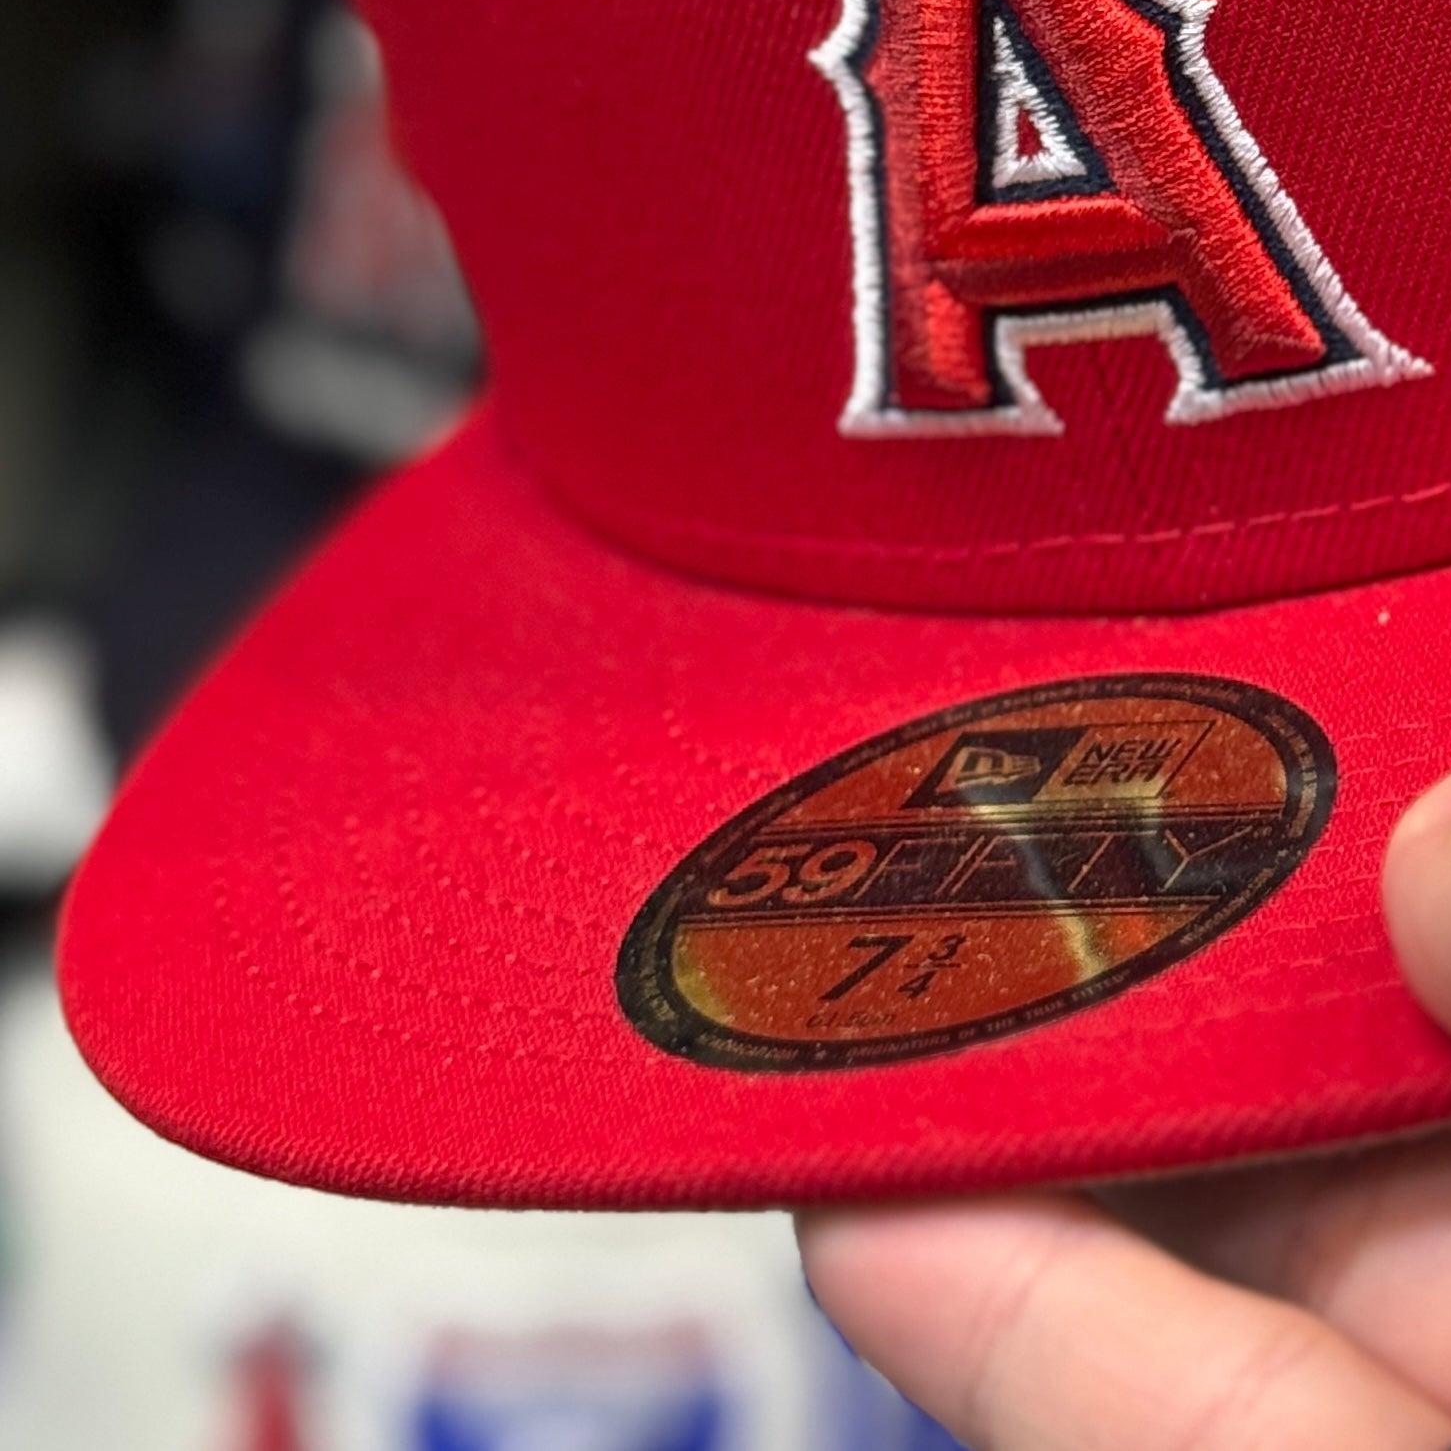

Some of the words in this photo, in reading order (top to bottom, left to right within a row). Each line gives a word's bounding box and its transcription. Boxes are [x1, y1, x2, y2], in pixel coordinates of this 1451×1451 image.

[1082, 737, 1182, 763] NEW
[1062, 759, 1165, 786] ERA
[706, 825, 1254, 908] 59FIFTY
[817, 934, 915, 1001] 7
[985, 1016, 1017, 1033] THE
